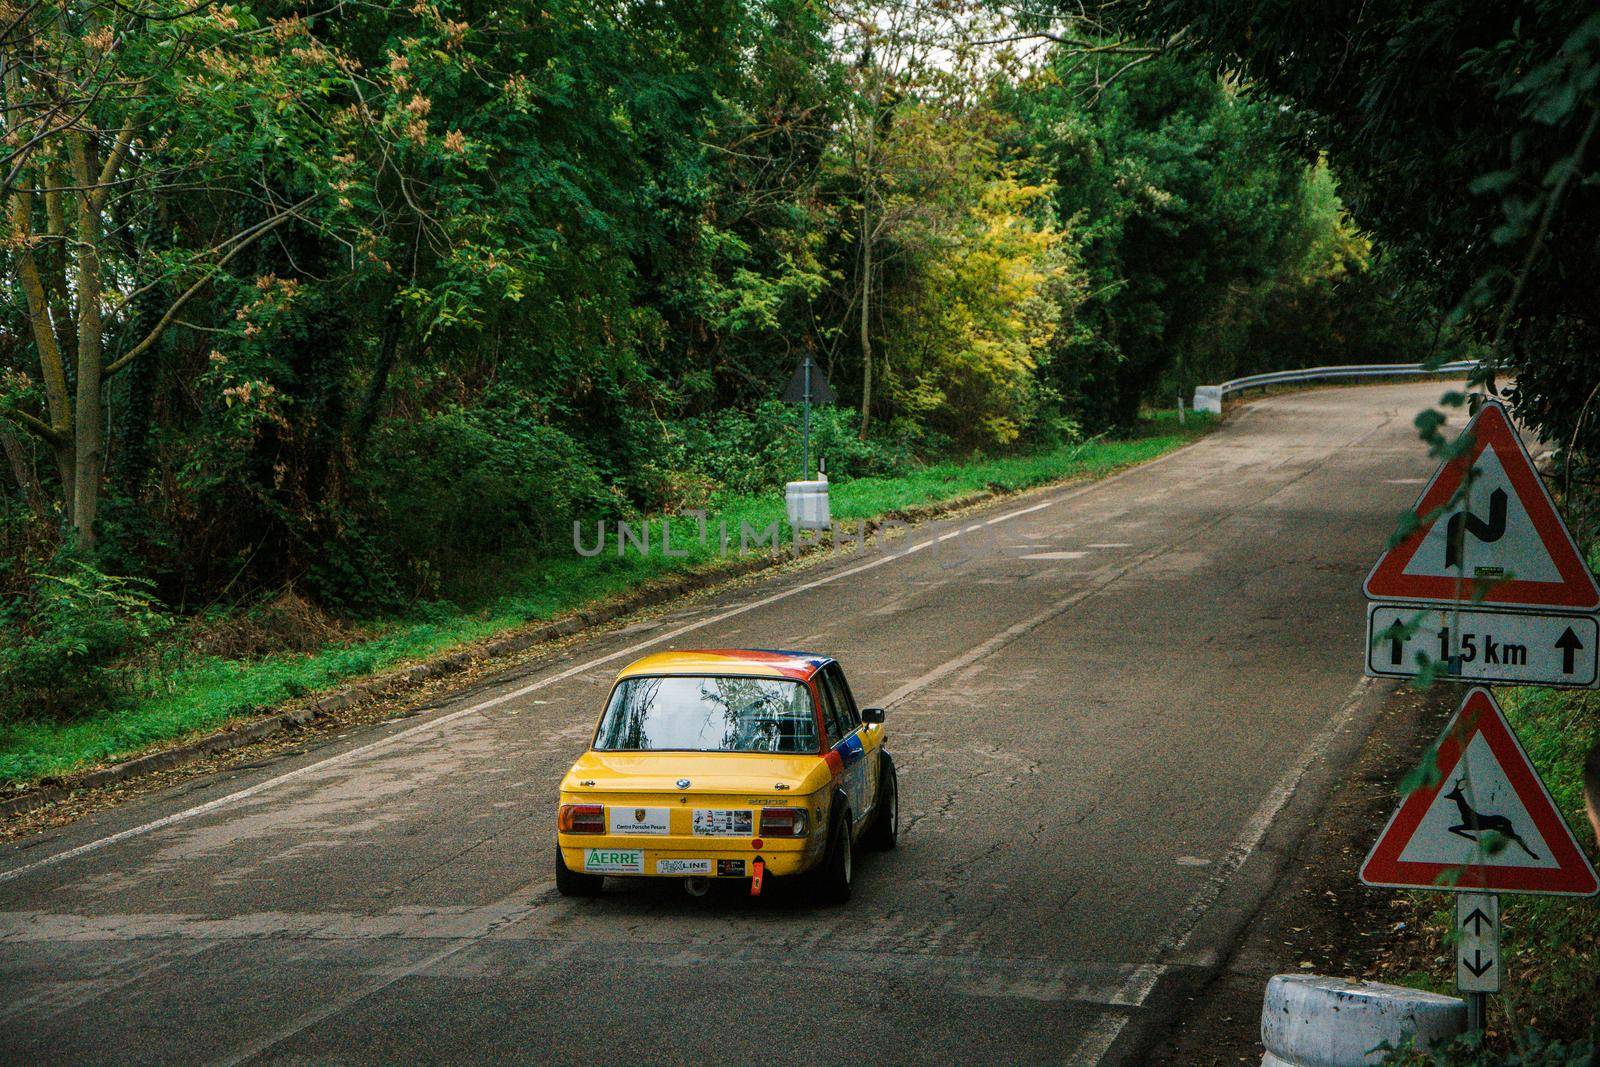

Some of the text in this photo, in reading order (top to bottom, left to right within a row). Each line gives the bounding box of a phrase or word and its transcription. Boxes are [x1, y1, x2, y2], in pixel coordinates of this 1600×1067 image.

[1437, 626, 1527, 666] 15 km
[587, 851, 639, 865] AERRE
